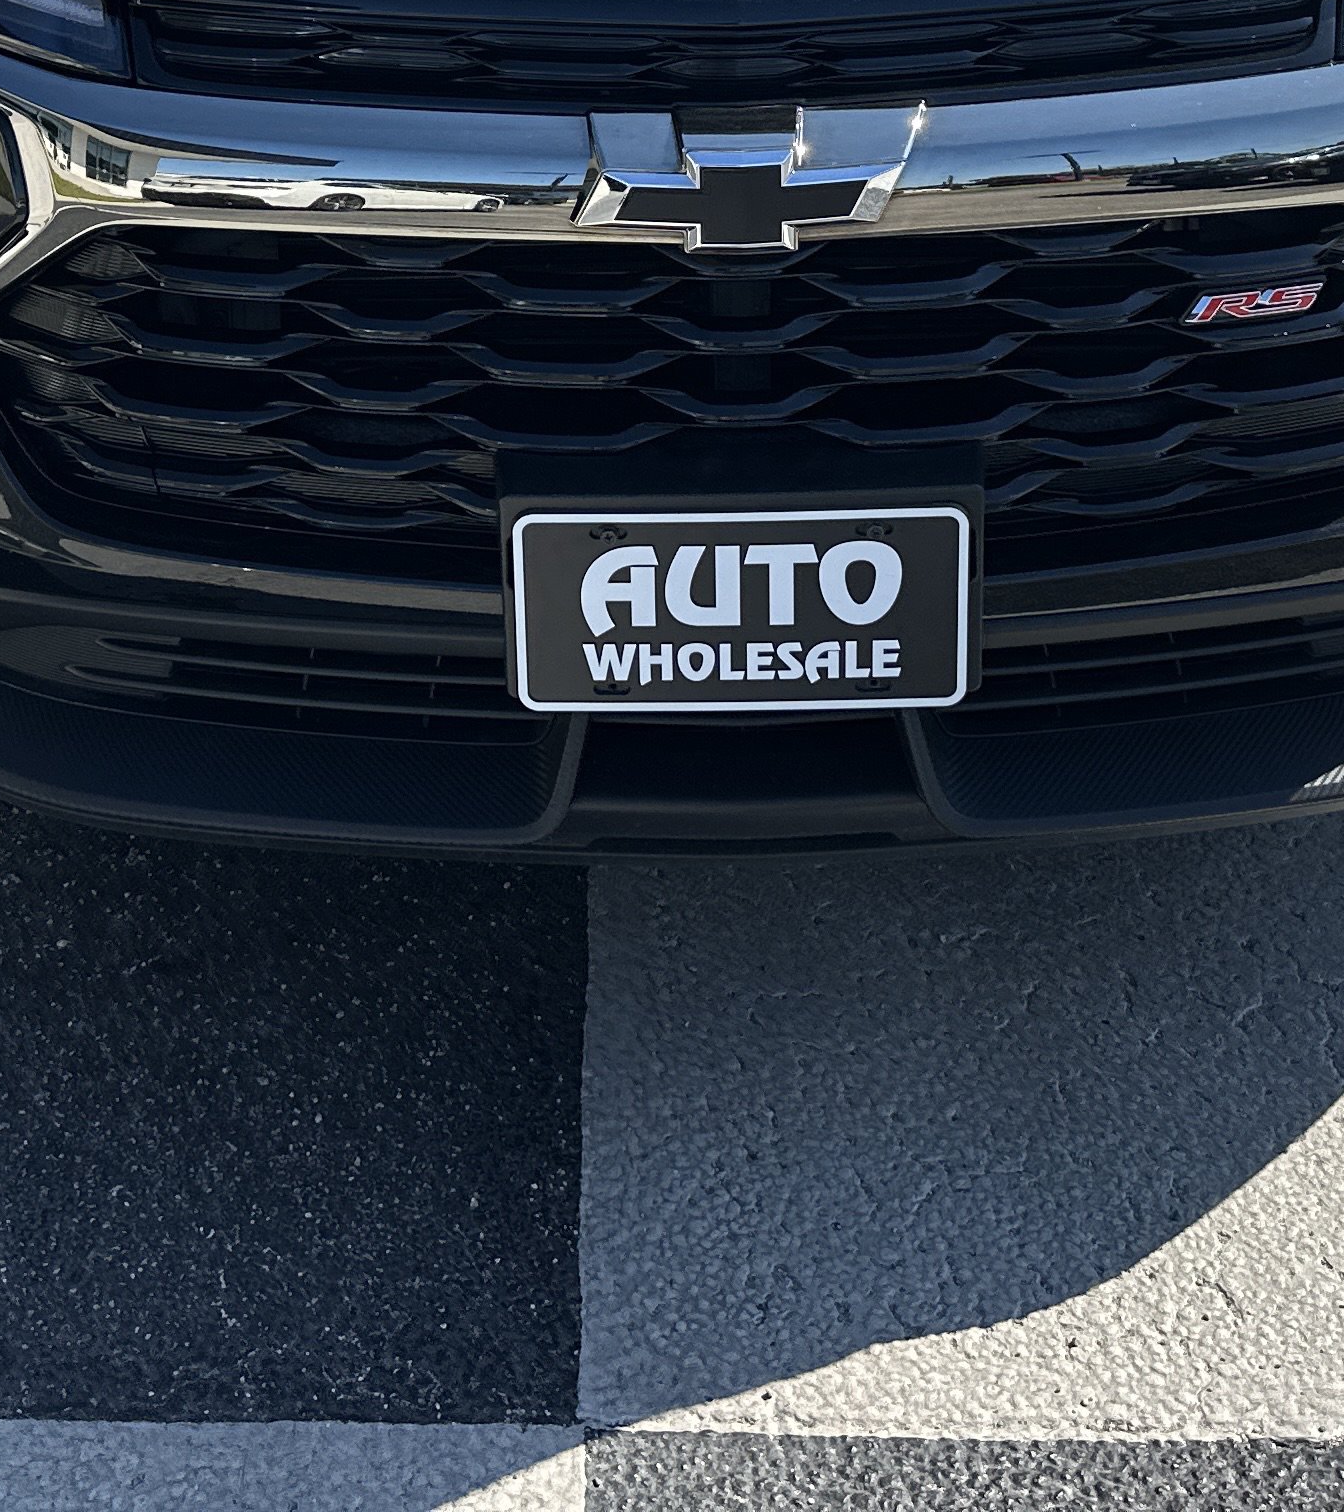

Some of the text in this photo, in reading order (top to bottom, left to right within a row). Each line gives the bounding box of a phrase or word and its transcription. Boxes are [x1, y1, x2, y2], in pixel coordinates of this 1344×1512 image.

[1185, 282, 1324, 323] RS
[581, 540, 903, 637] AUTO
[582, 639, 902, 686] WHOLESALE
